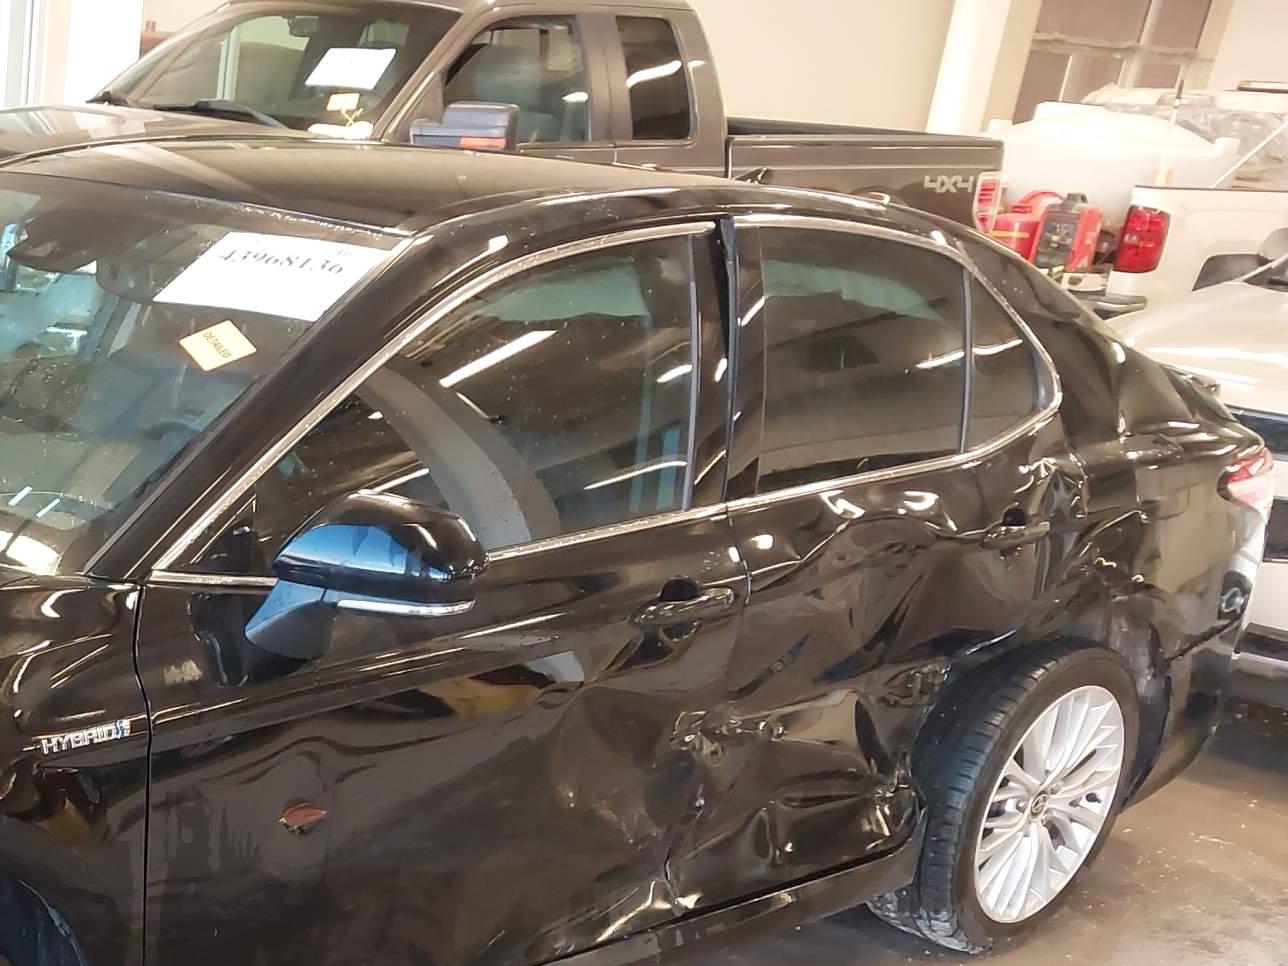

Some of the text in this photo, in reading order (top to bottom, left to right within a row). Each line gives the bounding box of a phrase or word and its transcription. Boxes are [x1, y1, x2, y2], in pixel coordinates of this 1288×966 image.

[220, 249, 344, 275] 43968136
[202, 332, 232, 359] DETAILED
[41, 723, 120, 755] HYBRID
